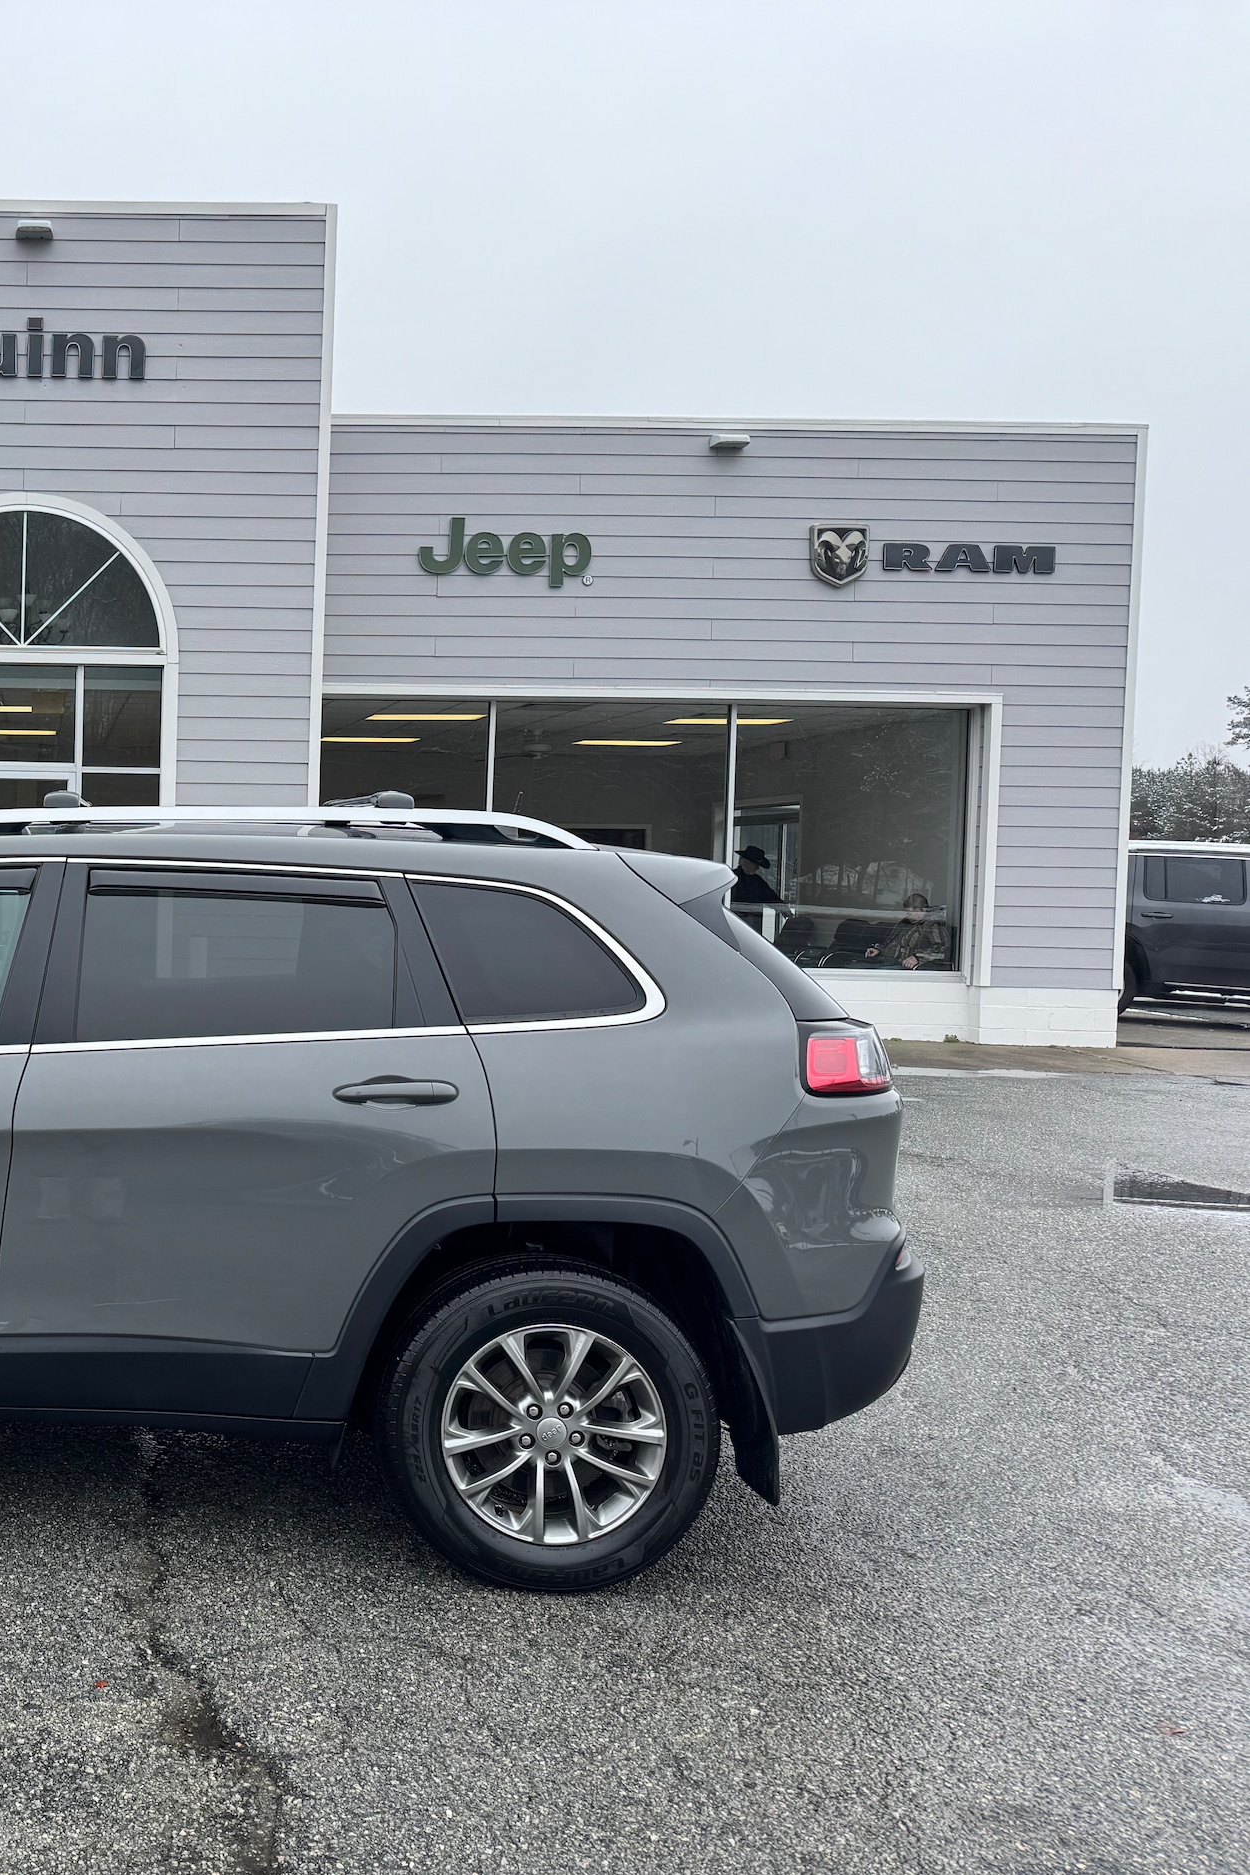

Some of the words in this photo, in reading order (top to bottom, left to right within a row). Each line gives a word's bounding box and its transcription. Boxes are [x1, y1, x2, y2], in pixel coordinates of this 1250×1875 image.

[418, 517, 592, 587] Jeep
[882, 542, 1057, 574] RAM
[541, 1424, 563, 1442] Jeep
